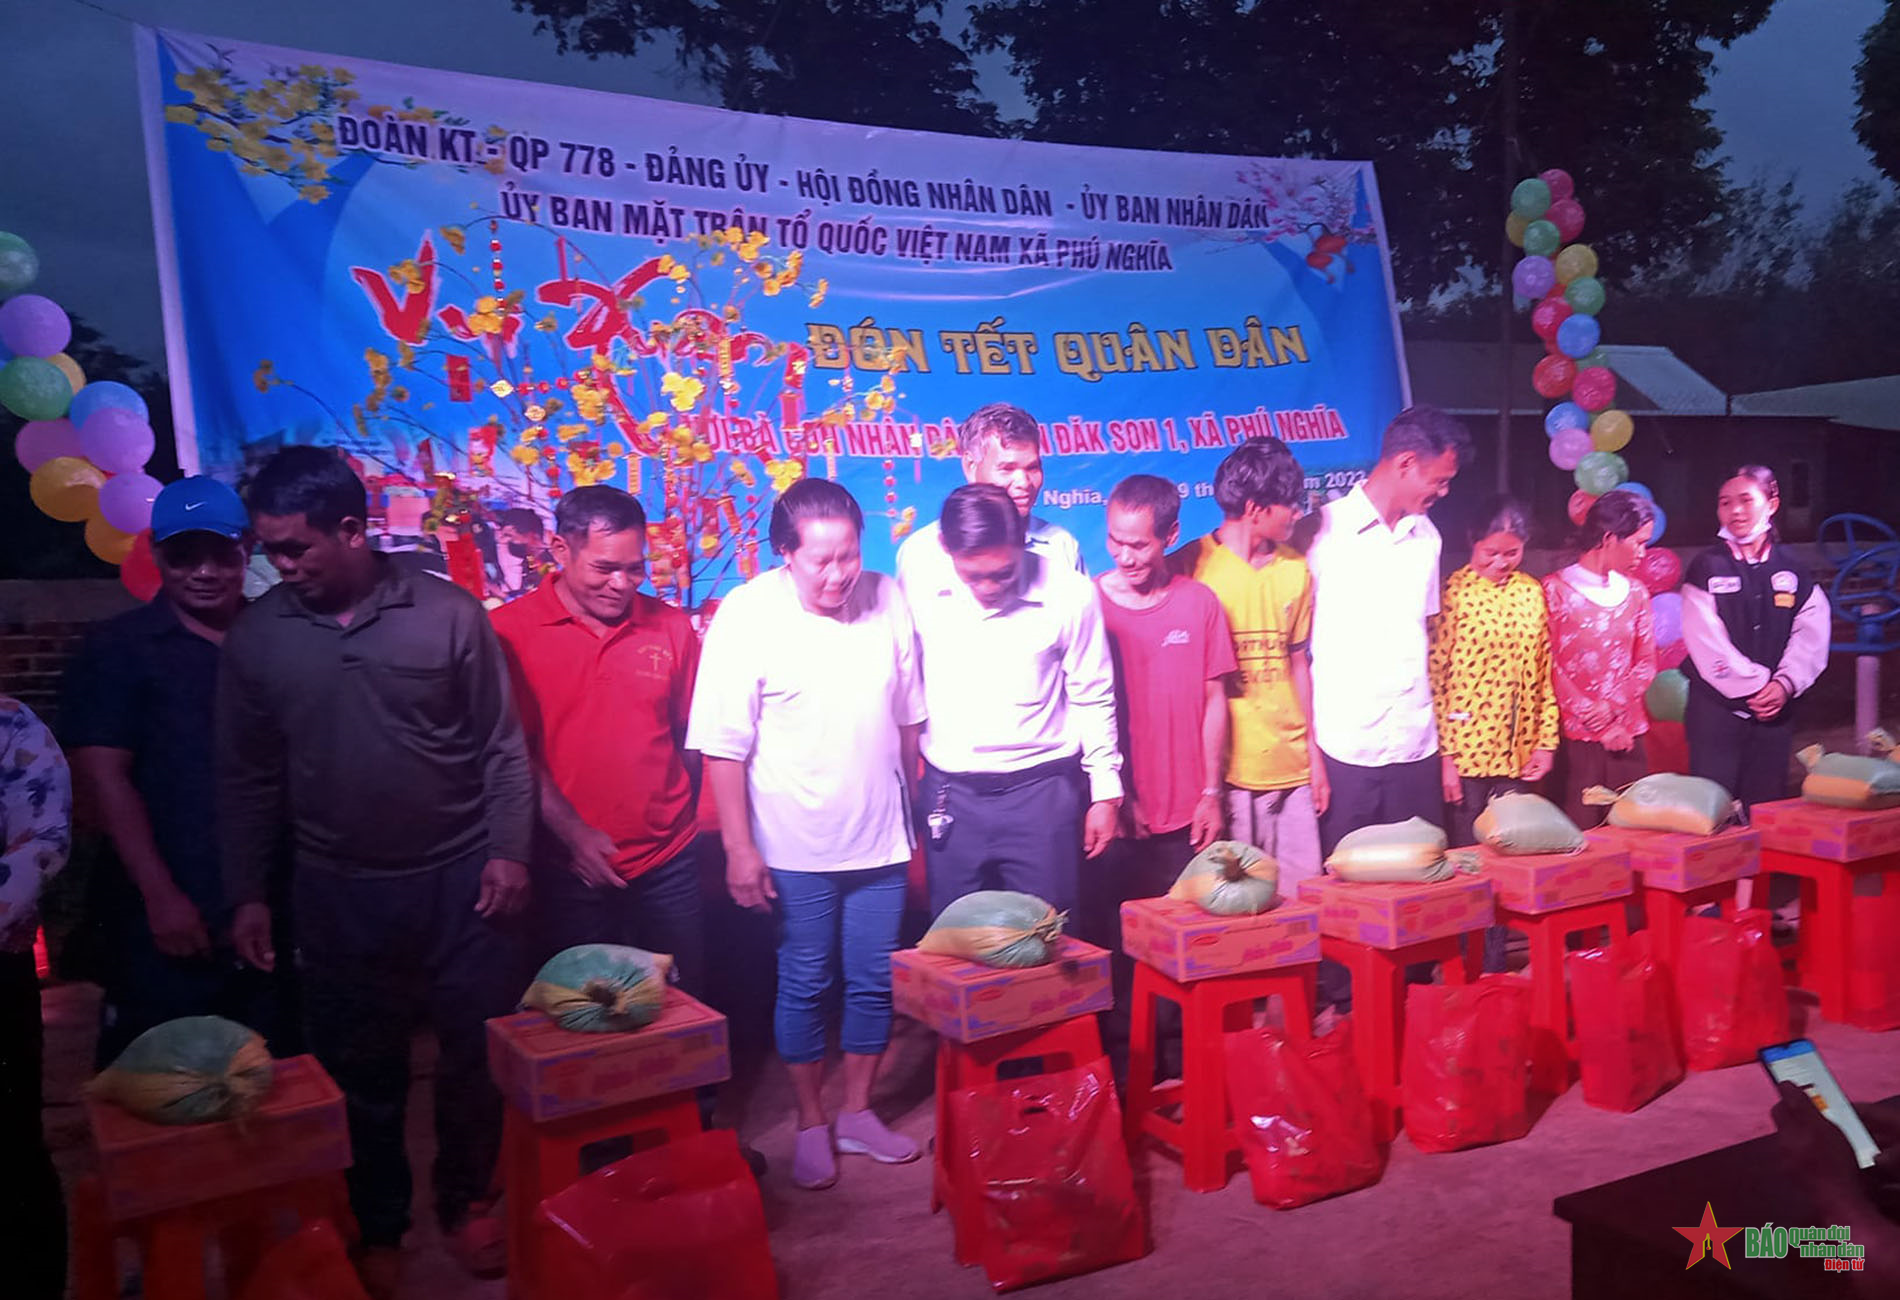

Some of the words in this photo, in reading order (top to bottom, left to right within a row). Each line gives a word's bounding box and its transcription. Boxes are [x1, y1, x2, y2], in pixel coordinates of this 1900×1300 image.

[337, 112, 428, 158] ĐOÀN
[510, 135, 549, 172] QP
[559, 141, 615, 177] 778
[645, 145, 727, 189] ĐẢNG
[733, 152, 769, 193] ỦY
[797, 168, 841, 206] HỘI
[926, 178, 997, 214] NHÂN
[1002, 184, 1053, 217] DÂN
[1081, 183, 1108, 220] ỦY
[1115, 194, 1159, 224] BAN
[1165, 194, 1222, 228] NHÂN
[1226, 198, 1270, 230] DÂN
[501, 181, 540, 222] ỦY
[550, 196, 612, 233] BAN
[623, 200, 685, 244] MẶT
[777, 209, 811, 249] TỔ
[818, 215, 887, 256] QUỐC
[897, 225, 948, 264] VIỆT
[954, 231, 1010, 264] NAM
[1019, 233, 1048, 266] XÃ
[1057, 235, 1098, 269] PHÚ
[1105, 241, 1173, 271] NGHĨA
[805, 316, 931, 373] ĐÓN
[938, 316, 1038, 374] TẾT
[1052, 322, 1198, 382] QUÂN
[1203, 315, 1311, 368] DÂN
[847, 417, 920, 457] NHÂN
[923, 417, 962, 457] DÂ
[1108, 418, 1160, 453] SON
[1188, 411, 1224, 448] XÃ
[1224, 406, 1273, 445] PHÚ
[1275, 403, 1348, 442] NGHĨA
